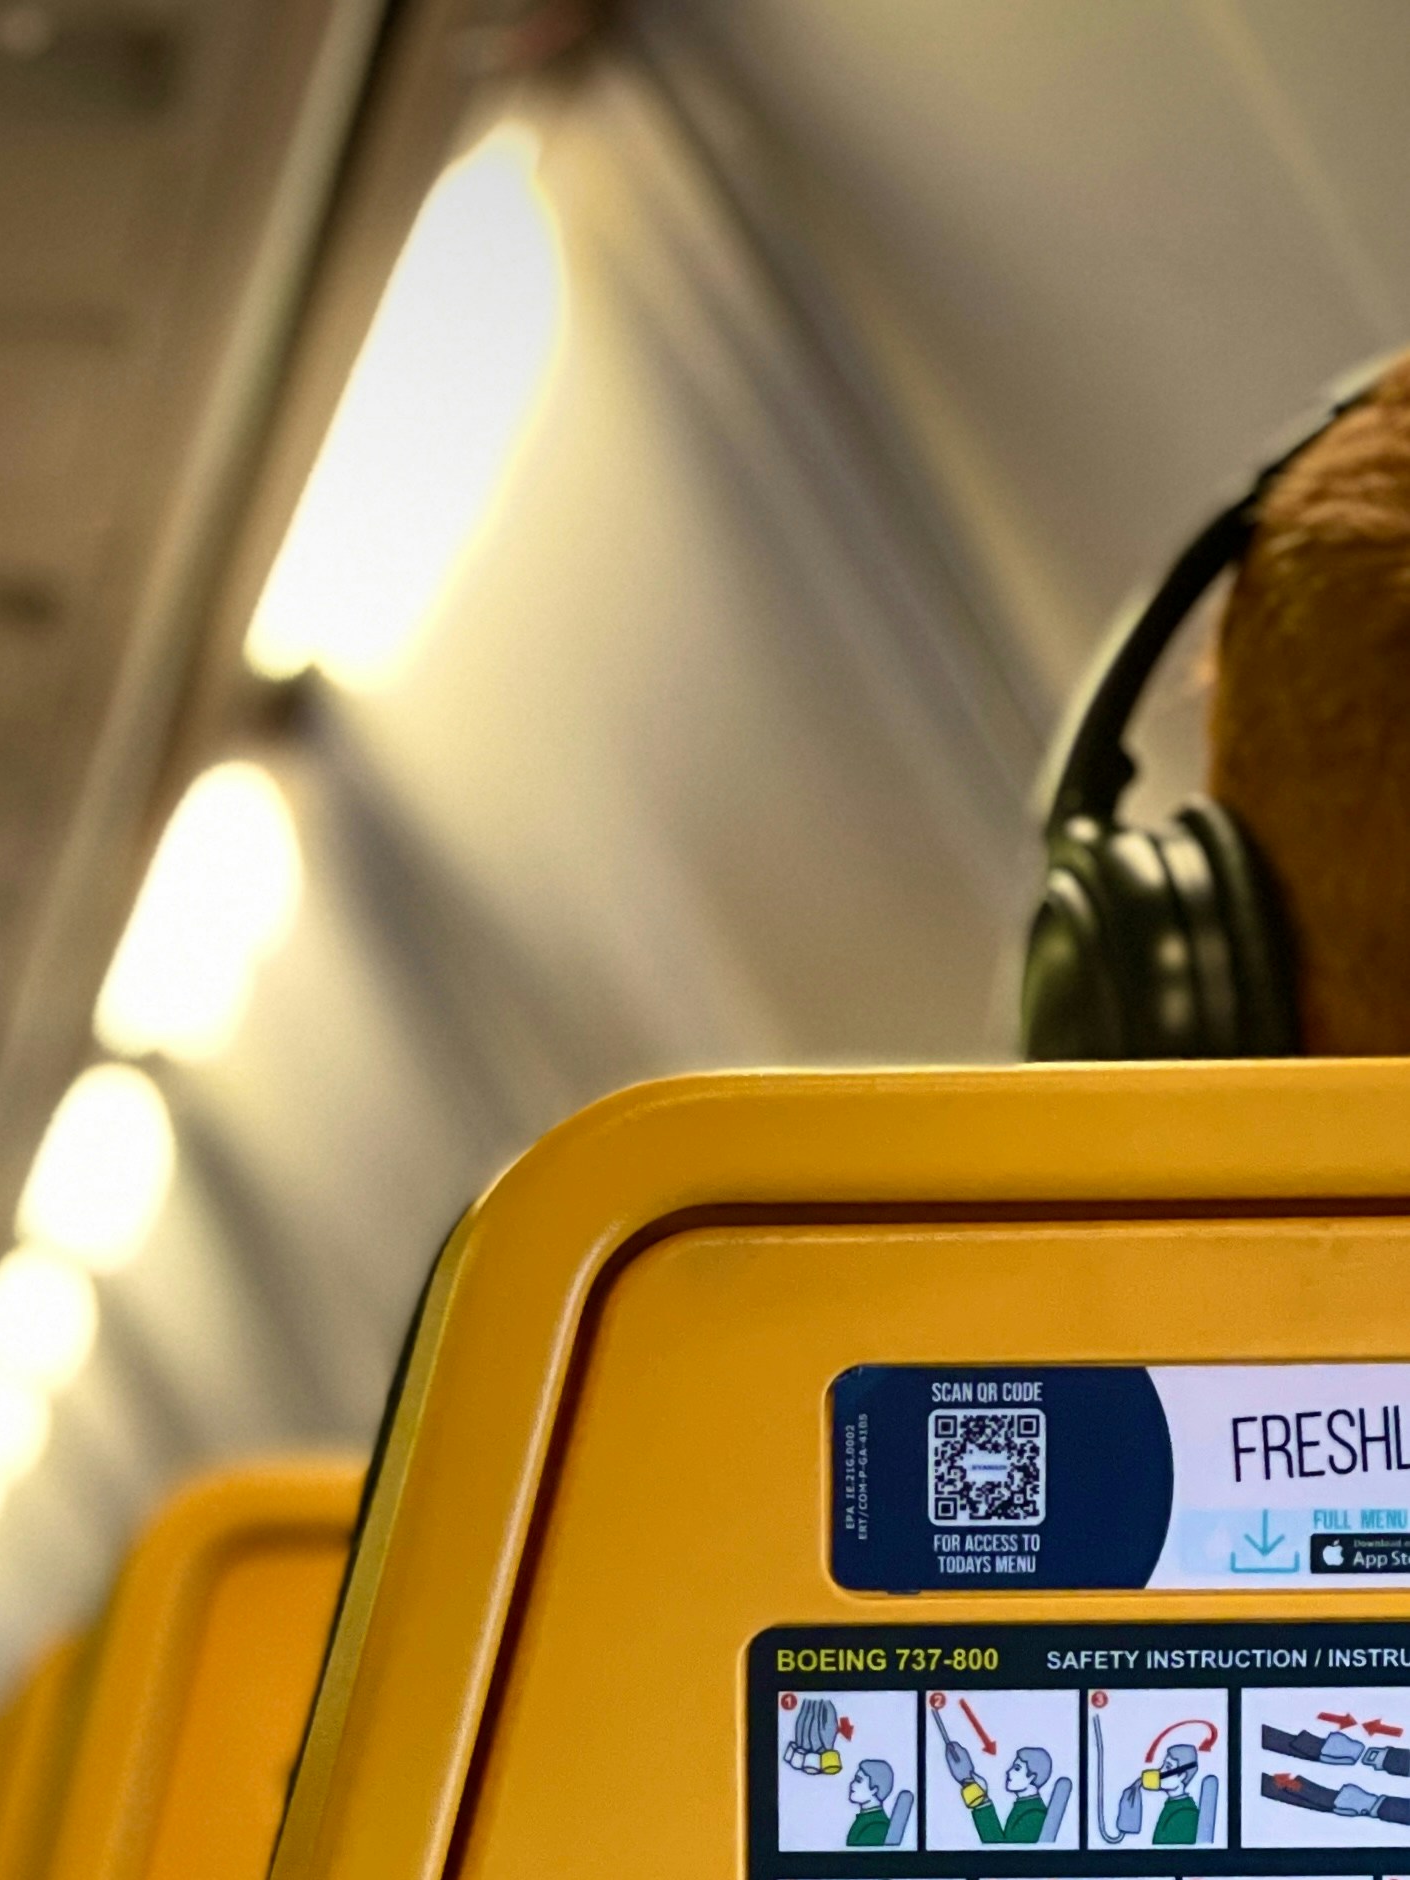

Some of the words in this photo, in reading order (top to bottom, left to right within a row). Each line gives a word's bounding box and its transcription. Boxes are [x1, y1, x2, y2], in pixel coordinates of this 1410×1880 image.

[931, 1382, 973, 1402] SCAN
[976, 1382, 998, 1403] QR
[1002, 1382, 1043, 1402] CODE
[1232, 1405, 1410, 1483] FRESHL
[845, 1505, 855, 1530] EPA
[1313, 1508, 1352, 1530] FULL
[1360, 1508, 1408, 1530] MENU
[933, 1534, 961, 1552] FOR
[964, 1534, 1018, 1552] ACCESS
[1022, 1533, 1041, 1552] TO
[1353, 1538, 1402, 1549] Download
[937, 1556, 991, 1574] TODAYS
[995, 1556, 1036, 1573] MENU
[1353, 1550, 1389, 1569] App
[777, 1648, 887, 1672] BOEING
[895, 1647, 999, 1671] 737-800
[1046, 1650, 1139, 1669] SAFETY
[1147, 1649, 1307, 1669] INSTRUCTION
[1313, 1648, 1321, 1668] /
[1328, 1648, 1410, 1668] INSTRU
